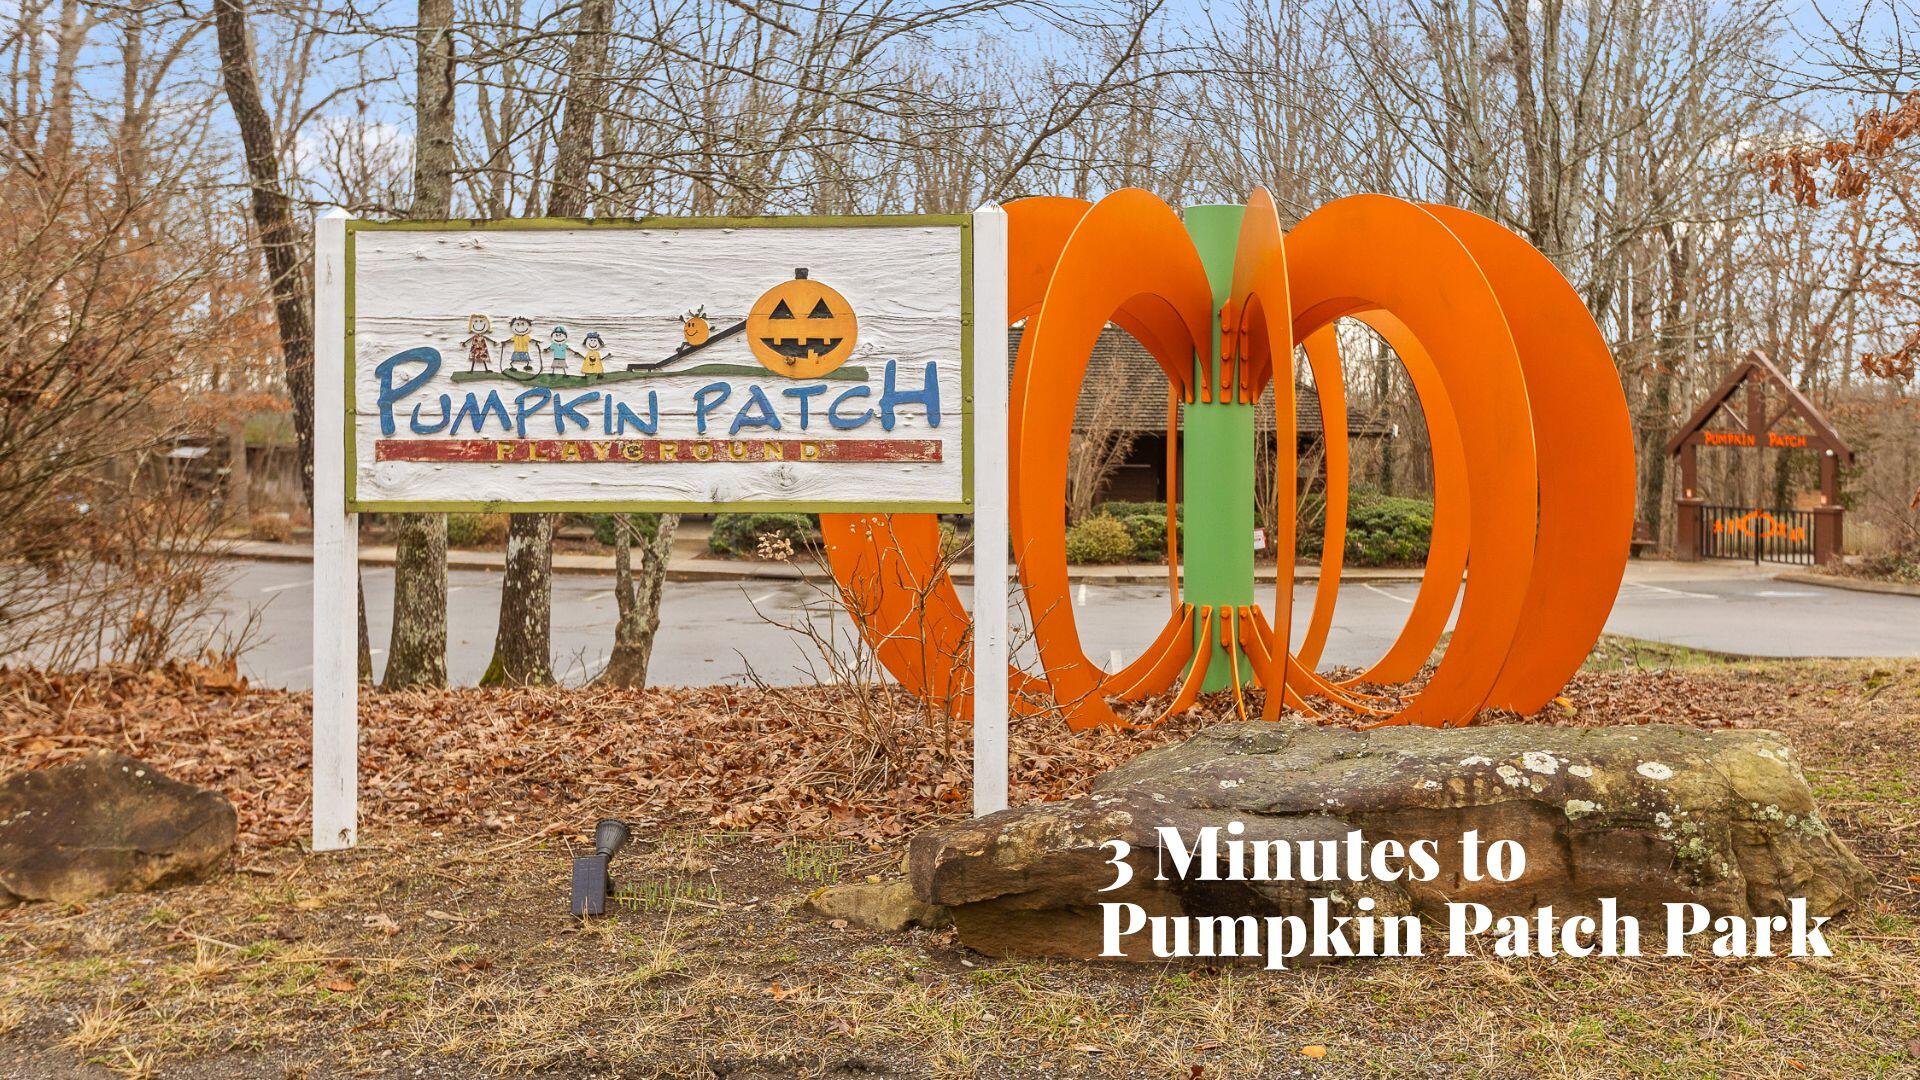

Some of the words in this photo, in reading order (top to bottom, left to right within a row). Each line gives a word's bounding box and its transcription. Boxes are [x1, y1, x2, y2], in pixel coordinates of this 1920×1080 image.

[375, 346, 658, 438] PUMPKIN
[693, 360, 942, 436] PATCH
[1704, 431, 1755, 446] PUMPKIN
[1769, 431, 1806, 447] PATCH
[497, 440, 822, 462] PLAYGROUND
